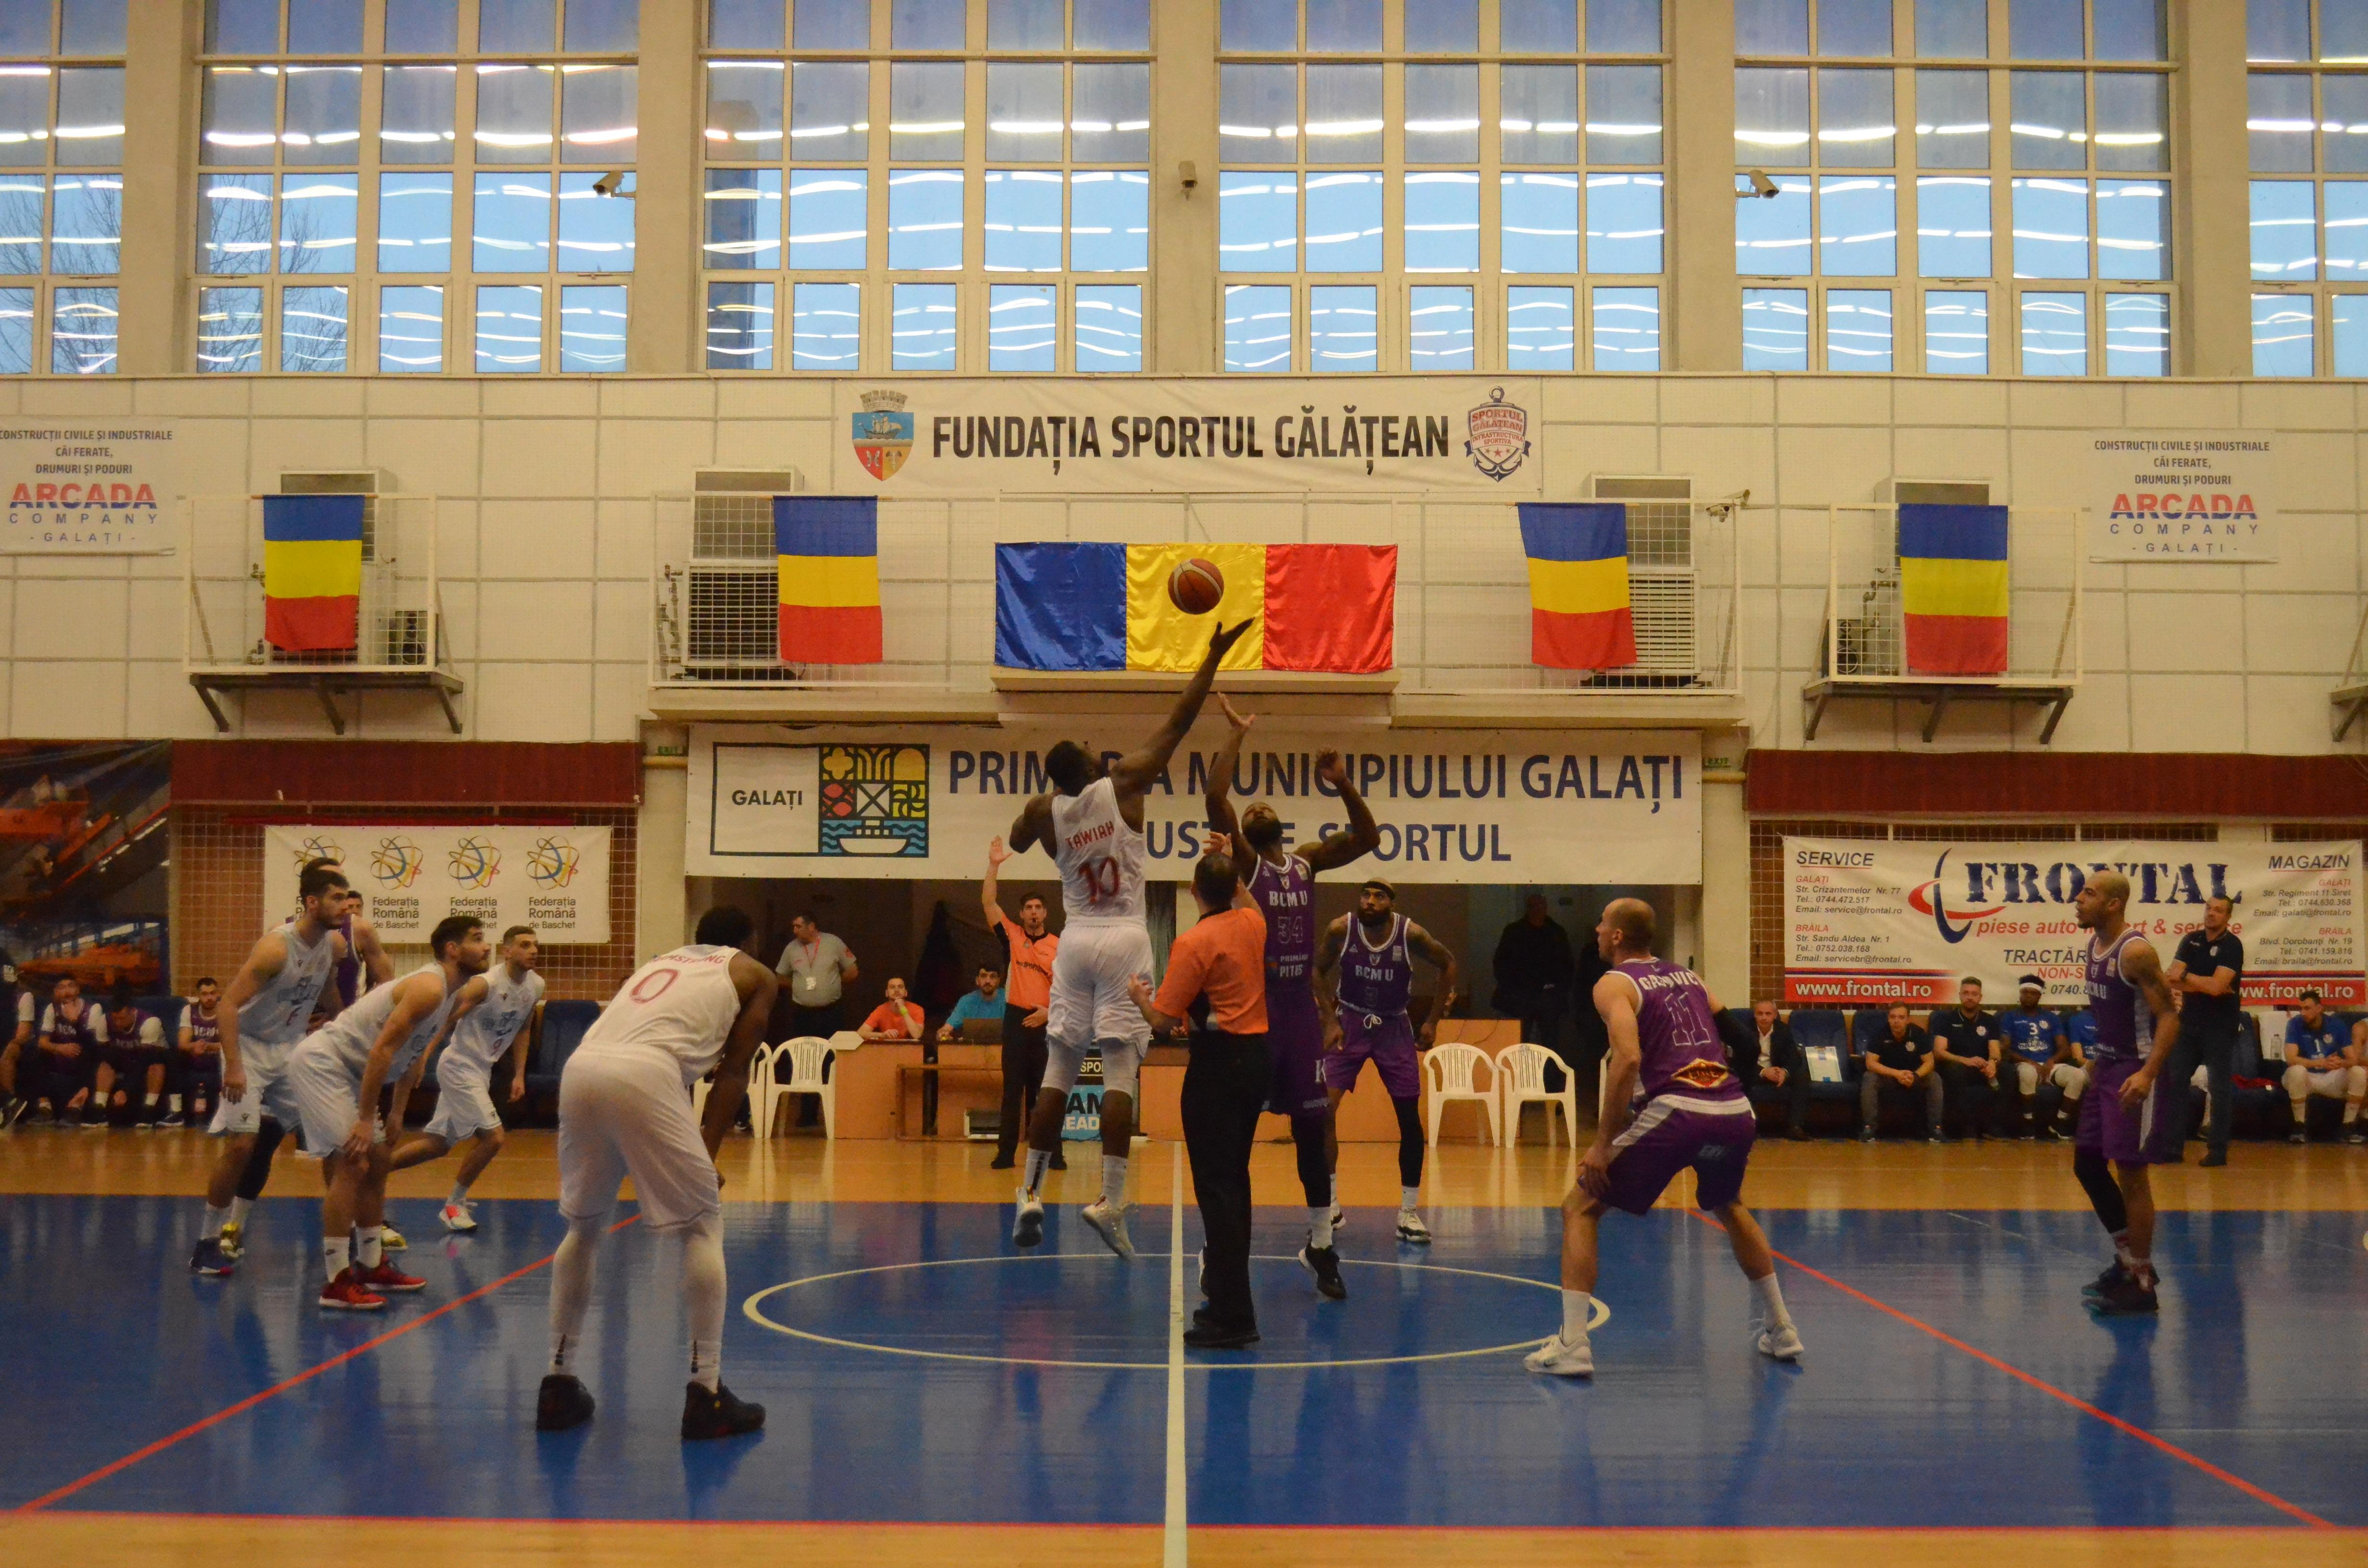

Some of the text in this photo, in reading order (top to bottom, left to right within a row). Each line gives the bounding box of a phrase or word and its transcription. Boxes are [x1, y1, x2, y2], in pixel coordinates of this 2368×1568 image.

[1472, 409, 1522, 422] SPORTUL
[64, 430, 94, 440] CIVILE
[97, 430, 106, 441] ȘI
[108, 430, 173, 440] INDUSTRIALE
[933, 405, 1449, 476] FUNDAȚIA SPORTUL GĂLĂȚEAN
[74, 447, 113, 458] FERATE,
[2095, 441, 2269, 453] CONSTRUCȚII CIVILE ȘI INDUSTRIALE
[2154, 455, 2211, 469] CĂI FERATE,
[36, 465, 132, 476] DRUMURI ȘI PODURI
[2135, 475, 2231, 487] DRUMURI ȘI PODURI
[10, 483, 158, 509] ARCADA
[2109, 493, 2257, 519] ARCADA
[9, 513, 157, 524] COMPANY
[2110, 524, 2257, 534] COMPANY
[950, 751, 1174, 795] PRIMA
[1521, 754, 1682, 814] GALAȚI
[732, 789, 802, 810] GALAȚI
[1065, 821, 1115, 850] TAWIAH
[1796, 851, 1874, 866] SERVICE
[2269, 855, 2350, 869] MAGAZIN
[1078, 856, 1120, 904] 10
[2279, 890, 2319, 898] Regiment
[373, 897, 419, 908] Federația
[450, 897, 497, 907] Federația
[529, 897, 576, 908] Federația
[373, 908, 419, 919] Română
[529, 907, 576, 919] Română
[1825, 906, 1902, 915] service@frontal.ro
[1278, 916, 1303, 943] 34
[1977, 918, 2030, 937] piese
[2035, 919, 2077, 934] auto
[2153, 919, 2166, 934] &
[1825, 955, 1912, 964] servicebr@frontal.ro
[2003, 946, 2087, 963] TRACTĂR
[2282, 957, 2353, 966] braila@frontal.ro
[629, 968, 680, 1004] 0
[1795, 980, 1932, 997] www.frontal.ro
[1665, 992, 1711, 1046] 11
[2029, 1022, 2038, 1035] 3
[1080, 1062, 1103, 1073] SPO
